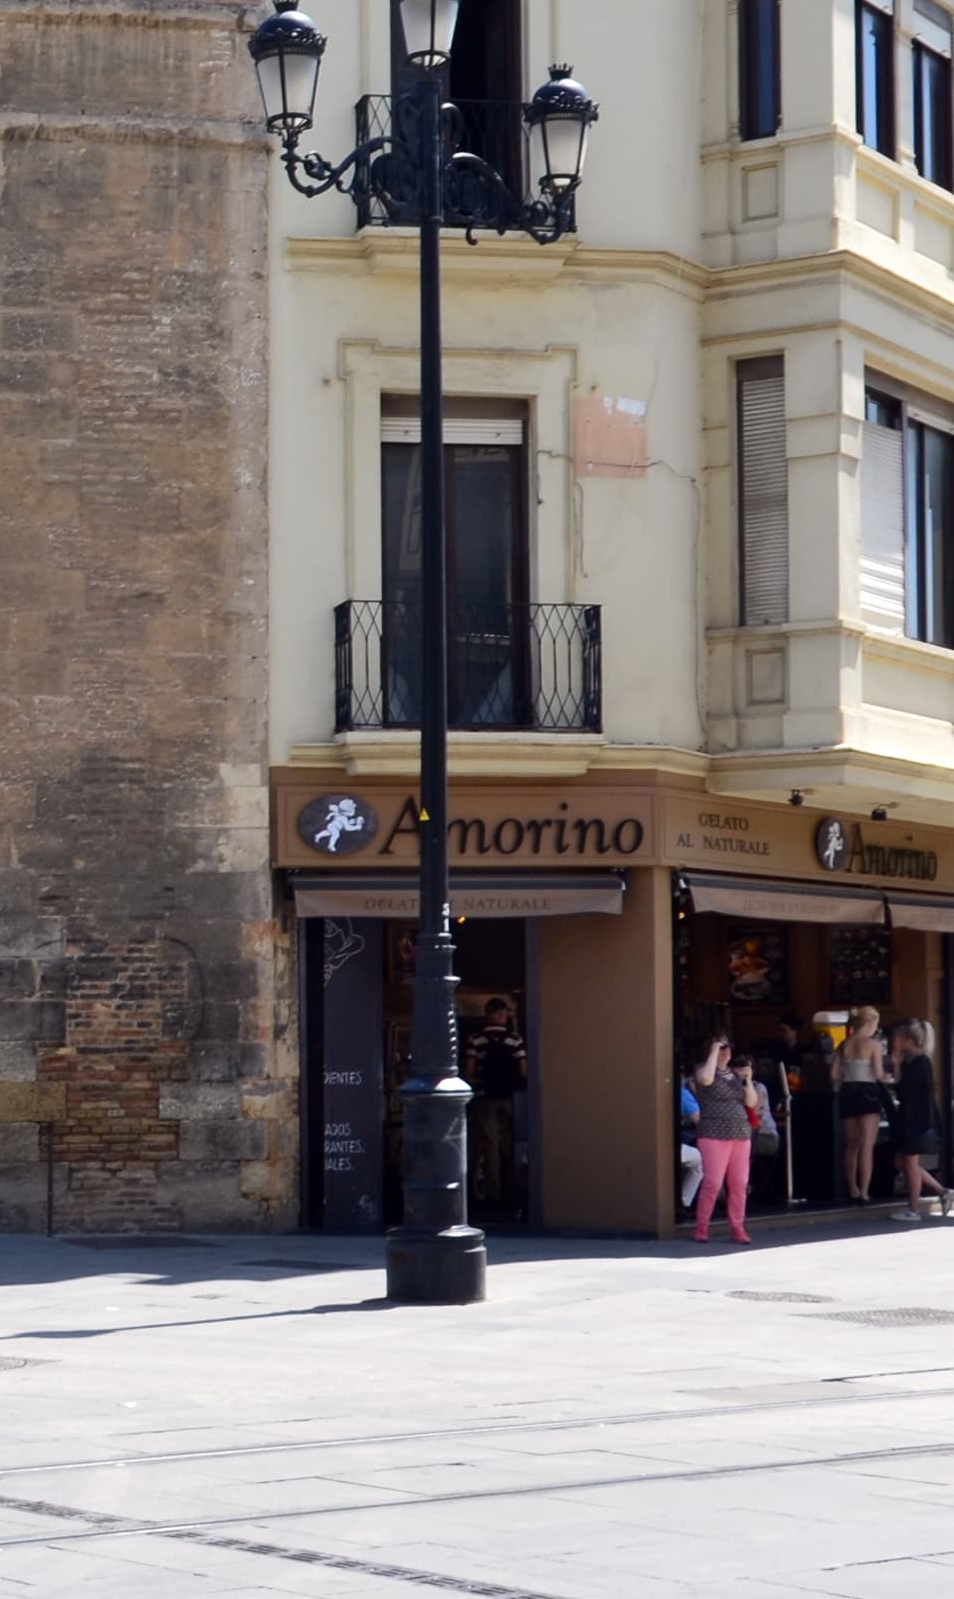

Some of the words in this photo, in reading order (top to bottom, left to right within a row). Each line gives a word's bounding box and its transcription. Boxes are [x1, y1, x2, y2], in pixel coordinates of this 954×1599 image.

[698, 812, 750, 831] GELATO
[676, 833, 694, 848] AL
[702, 835, 771, 855] NATURALE
[847, 821, 938, 882] Amorino
[364, 897, 417, 911] GELAT
[462, 897, 551, 911] NATURALE
